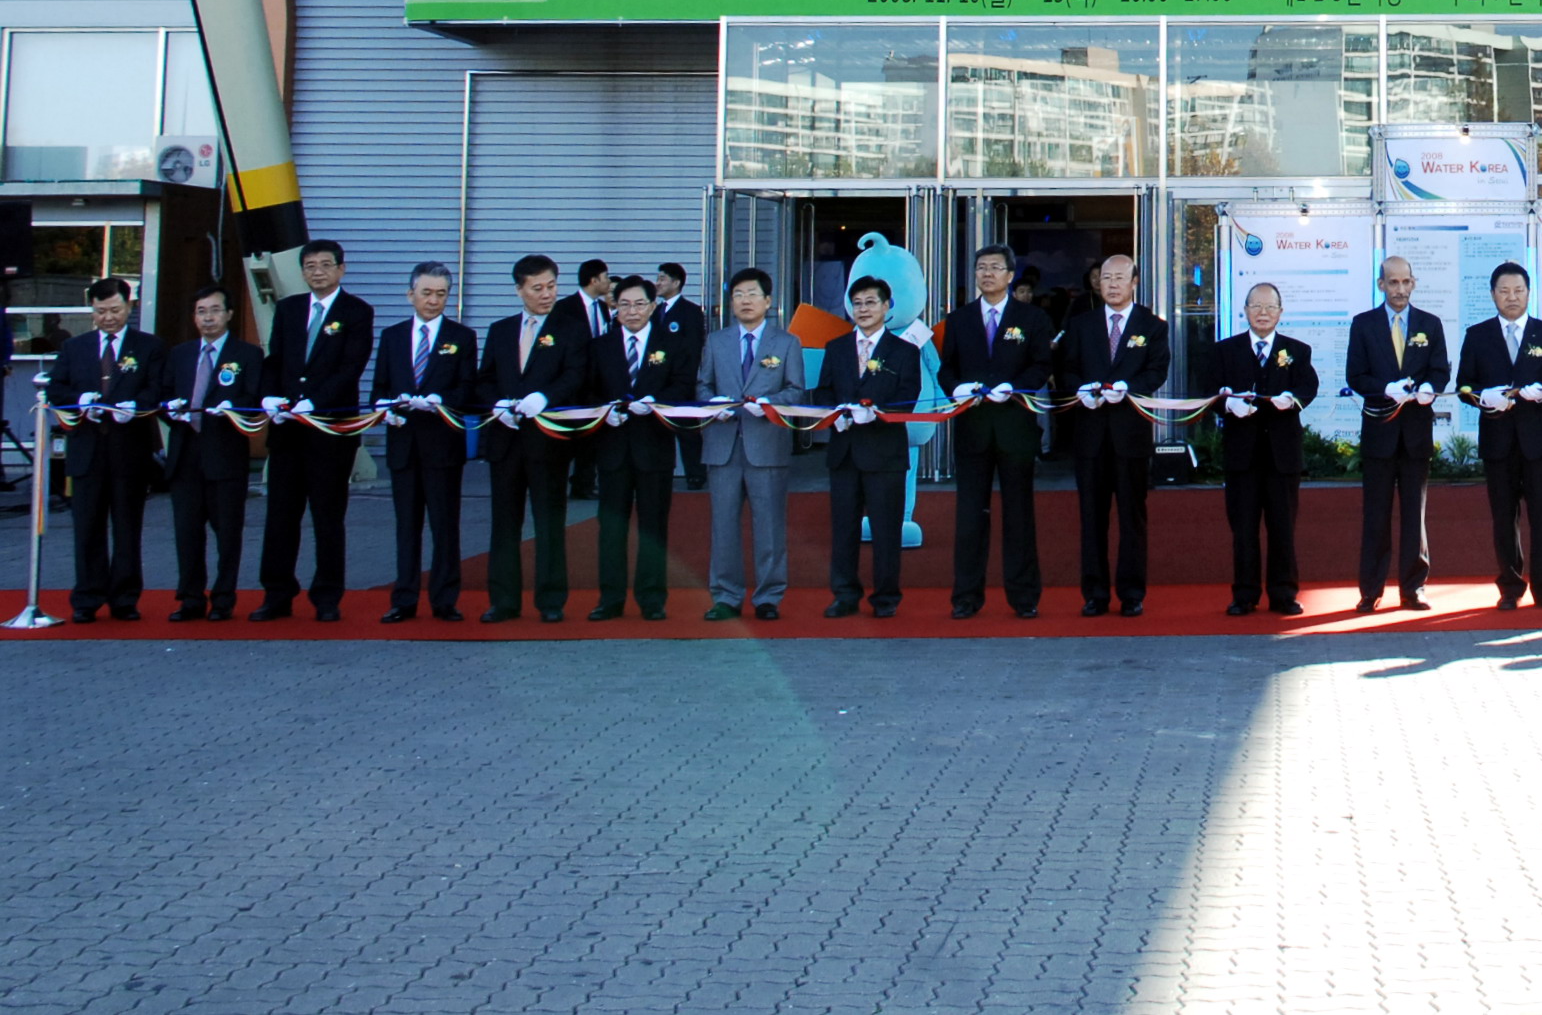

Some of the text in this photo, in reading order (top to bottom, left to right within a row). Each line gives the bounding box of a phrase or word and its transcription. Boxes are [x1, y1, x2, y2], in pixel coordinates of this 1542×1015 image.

[1421, 152, 1443, 161] 2008
[199, 159, 210, 167] LG
[1421, 161, 1509, 174] WATER KOREA
[1276, 239, 1349, 250] WATER KOREA
